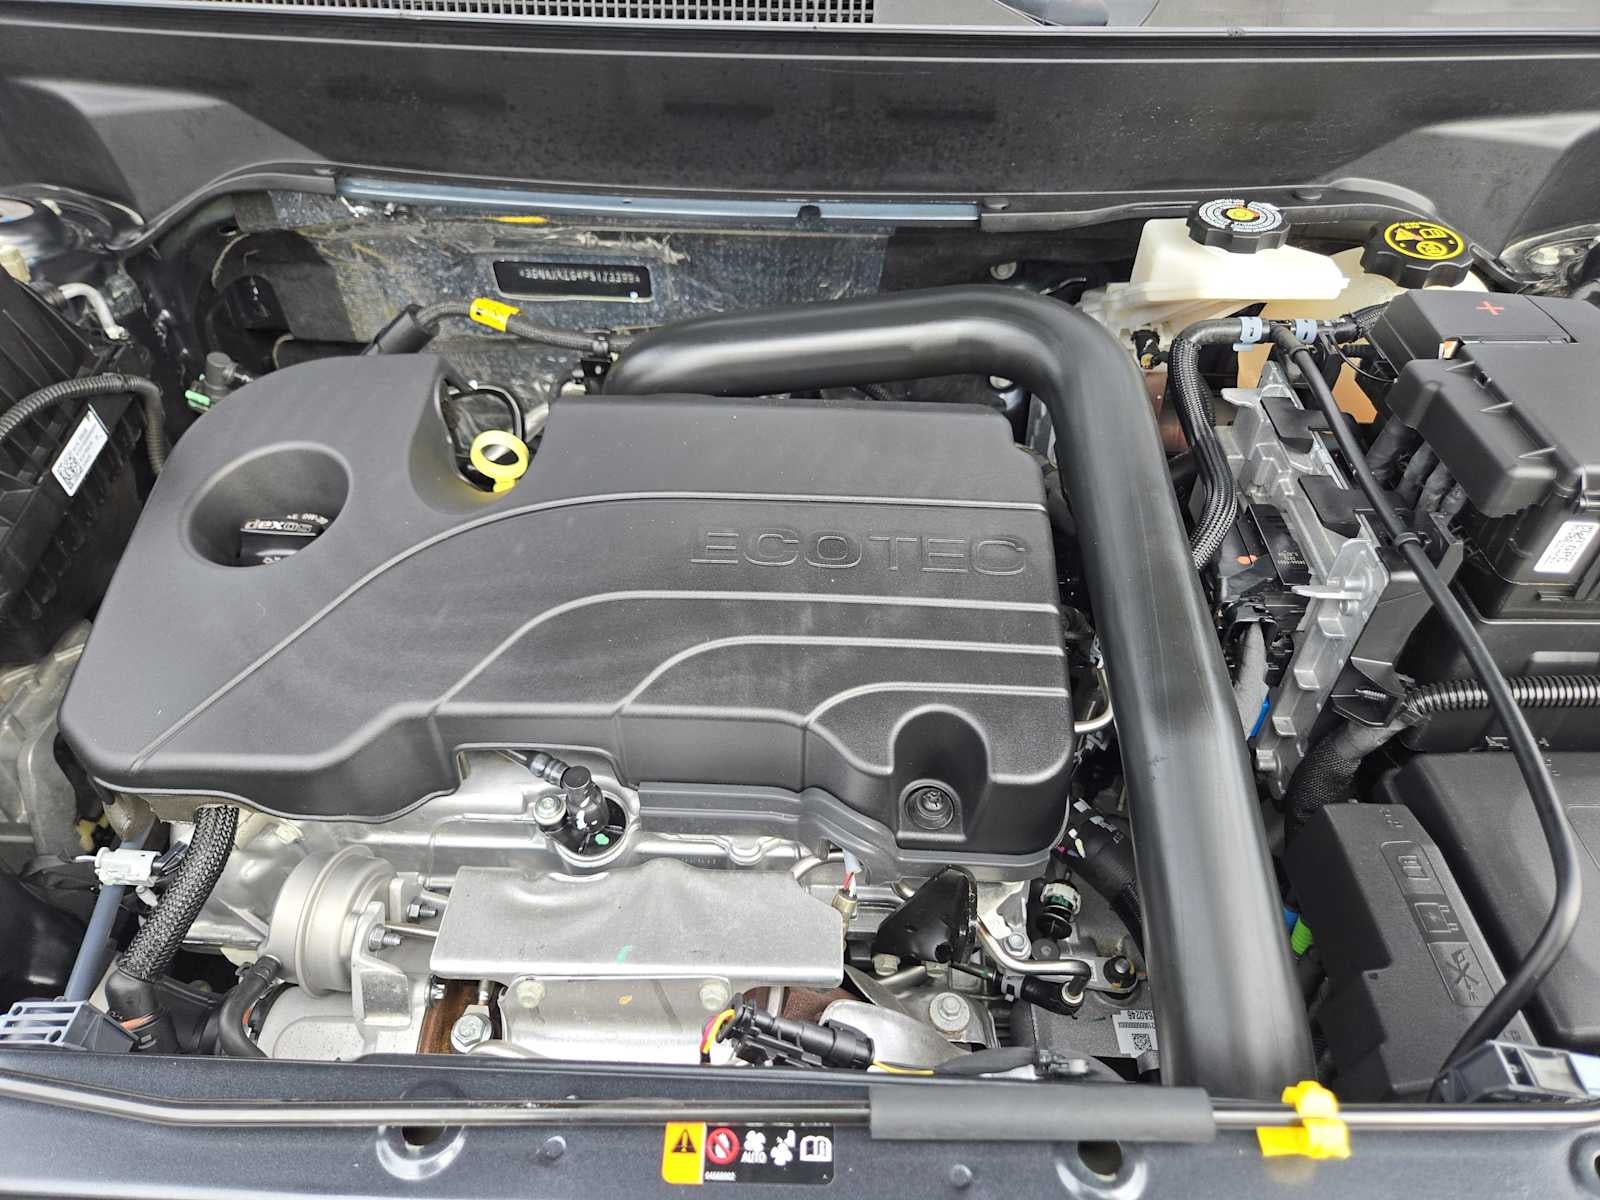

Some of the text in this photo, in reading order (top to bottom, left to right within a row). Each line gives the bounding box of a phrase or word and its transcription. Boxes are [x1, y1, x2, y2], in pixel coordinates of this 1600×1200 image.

[244, 519, 313, 533] dexos
[689, 527, 1026, 577] ECOTEC
[740, 1150, 768, 1164] AUTO
